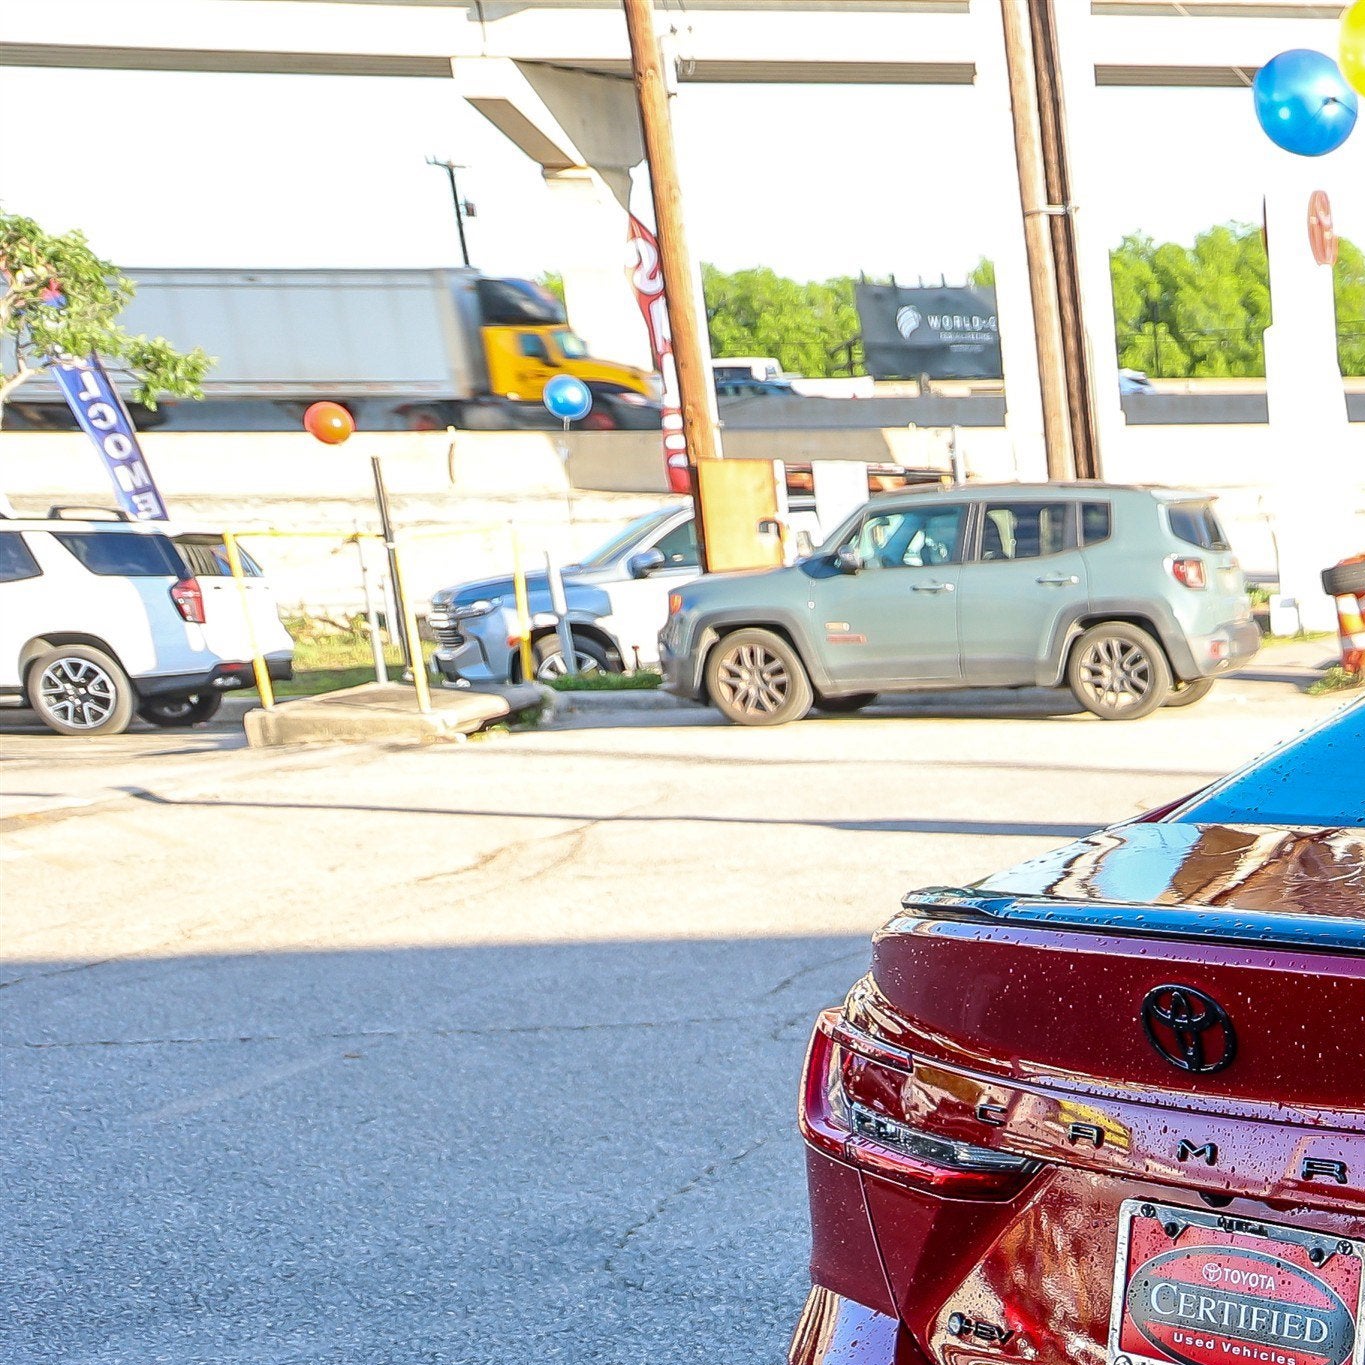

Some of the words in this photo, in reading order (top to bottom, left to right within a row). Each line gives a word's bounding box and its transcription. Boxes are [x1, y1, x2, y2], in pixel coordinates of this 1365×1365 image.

[1223, 1267, 1276, 1291] TOYOTA
[1150, 1282, 1329, 1344] CERTIFIED
[1173, 1331, 1215, 1350] Used
